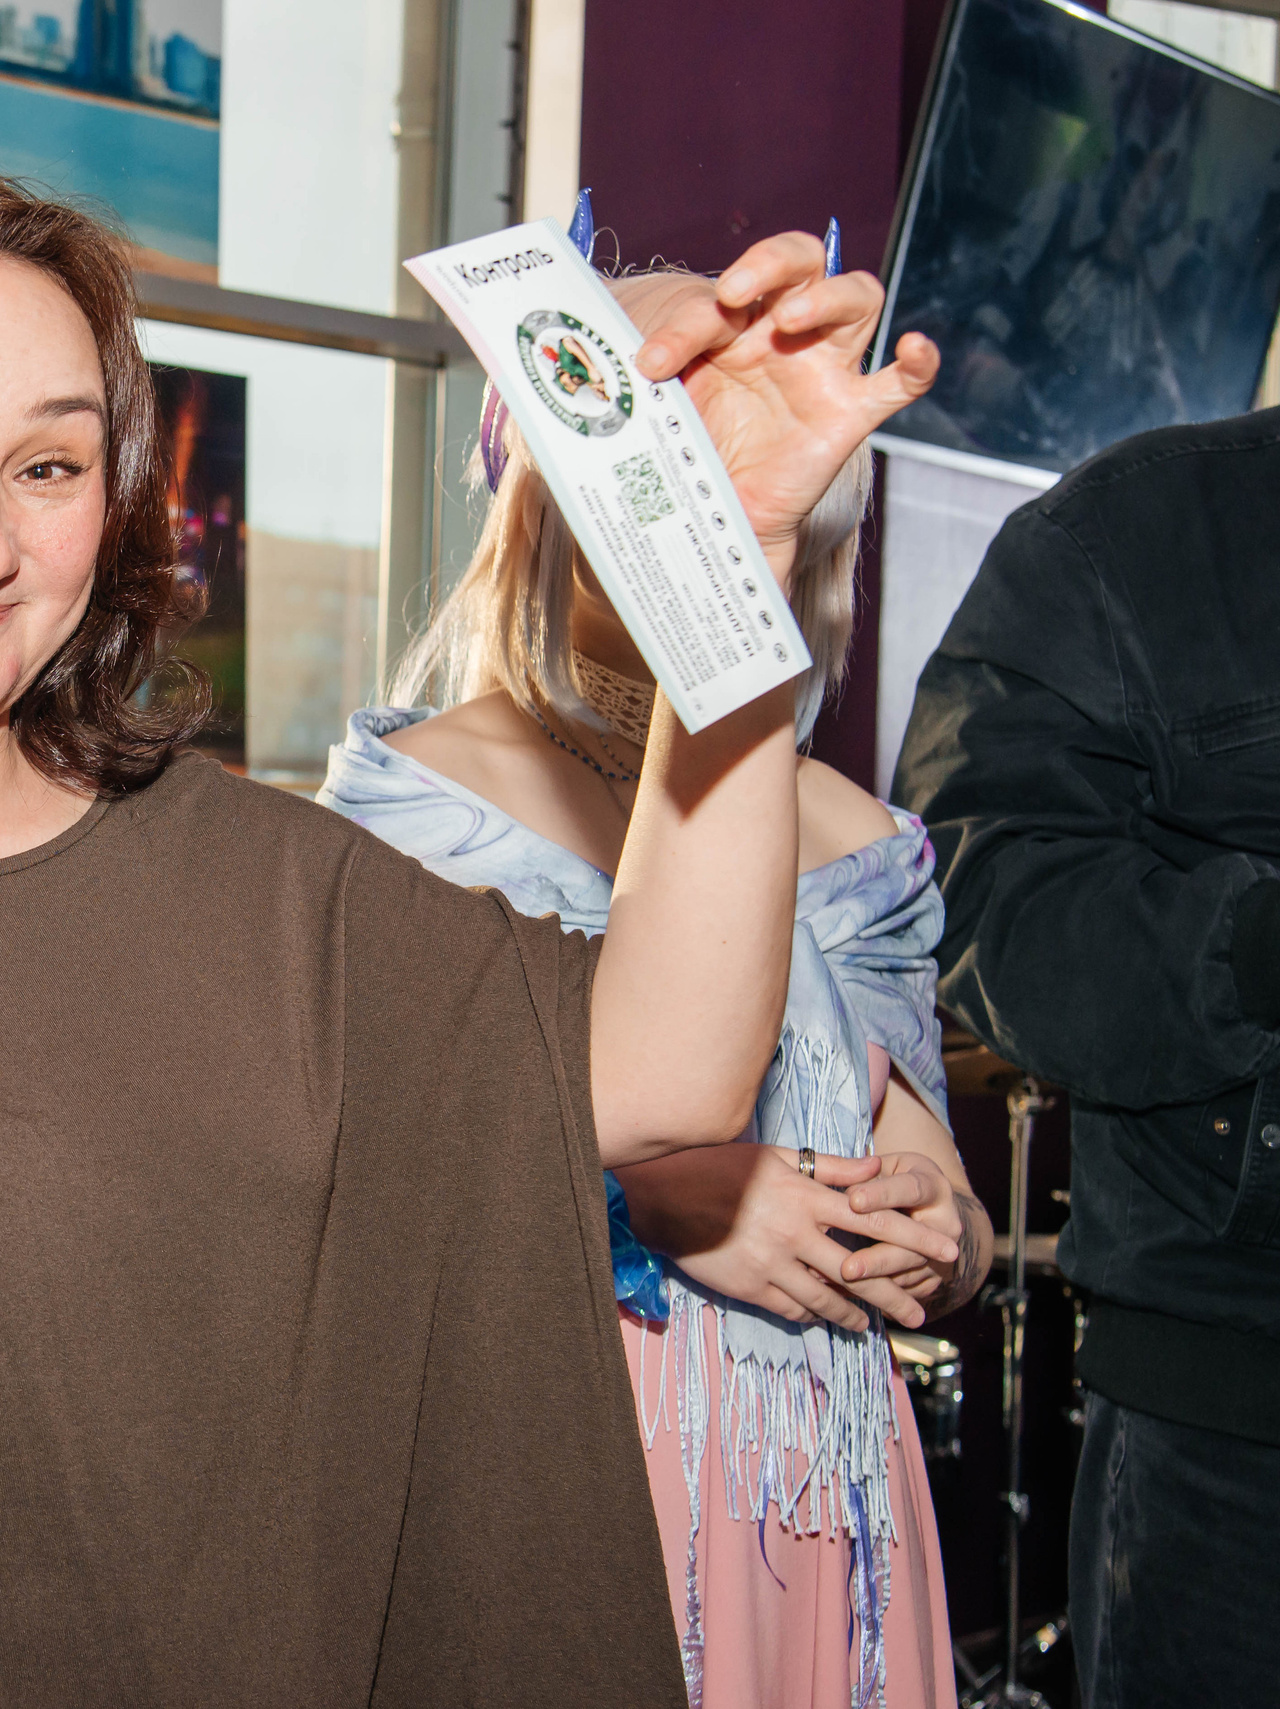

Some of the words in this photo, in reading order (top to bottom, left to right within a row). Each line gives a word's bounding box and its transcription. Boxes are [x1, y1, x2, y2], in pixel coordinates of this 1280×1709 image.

[453, 247, 554, 289] Контроль
[683, 522, 725, 599] ПРОДАЖИ
[720, 601, 744, 635] ДЛЯ
[738, 636, 755, 658] НЕ
